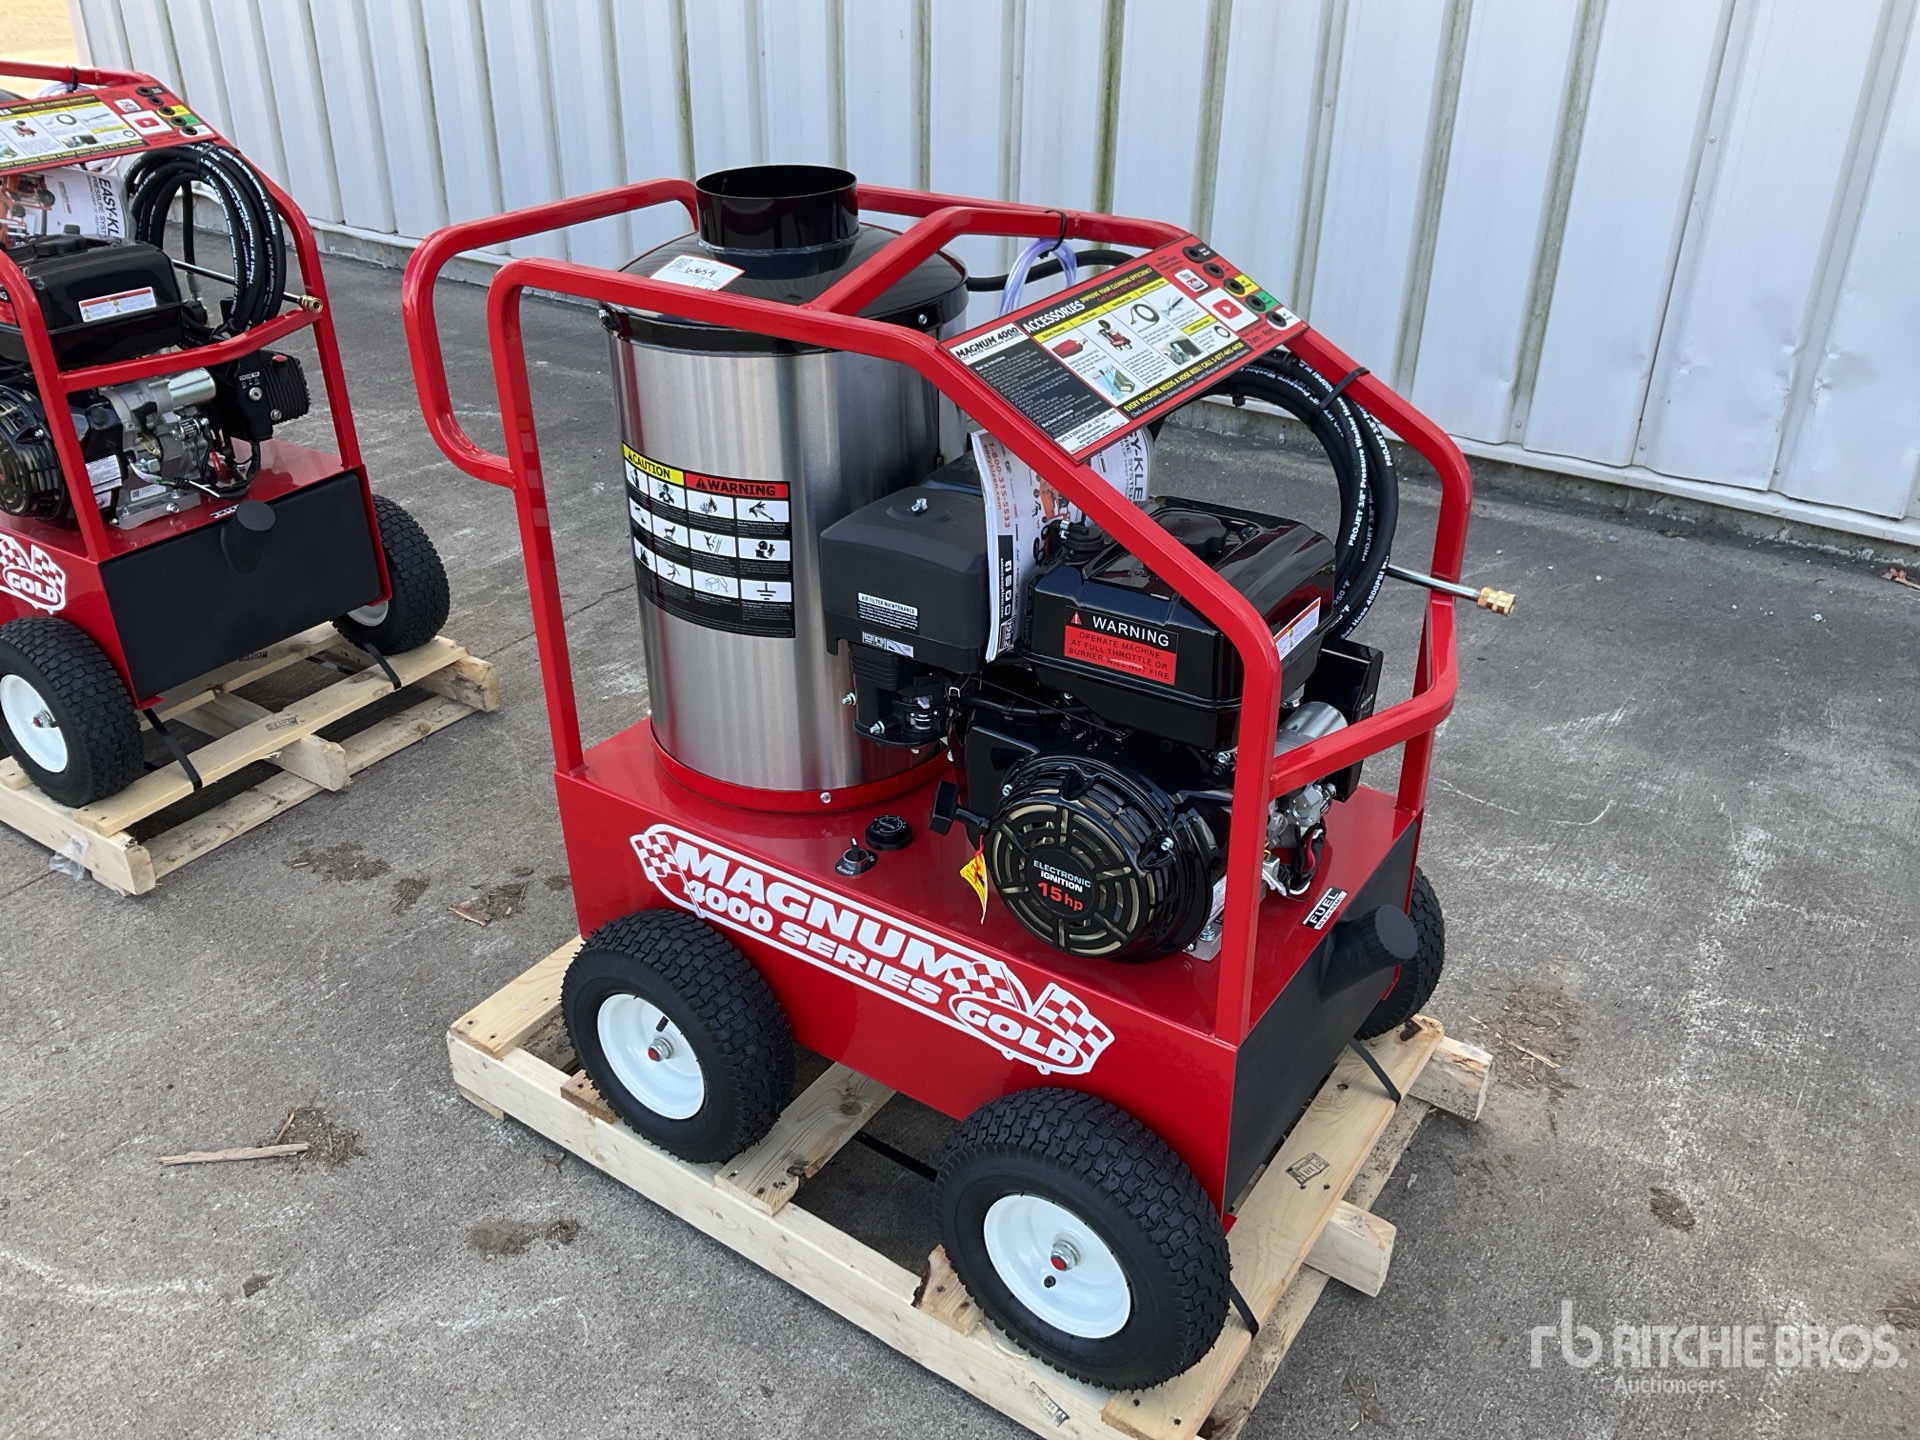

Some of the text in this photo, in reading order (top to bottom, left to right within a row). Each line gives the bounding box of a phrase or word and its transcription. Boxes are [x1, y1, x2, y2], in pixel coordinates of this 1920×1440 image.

[1019, 299, 1088, 334] ACCESSORIES
[953, 325, 1021, 359] MAGNUM 4000
[1122, 399, 1141, 412] EVERY
[1136, 387, 1163, 403] MACHINE
[1157, 379, 1177, 392] NEEDS
[1175, 370, 1192, 381] HOSE
[1199, 358, 1214, 368] CALL
[632, 454, 671, 480] CAUTION
[1376, 435, 1393, 467] PROJET
[707, 479, 776, 497] WARNING
[983, 444, 1002, 511] easykleen.com
[988, 441, 1011, 528] 1-800-315-5533
[1336, 396, 1369, 547] PROJET 3/8" Pressure Washer Hose
[6, 571, 58, 603] GOLD
[1351, 606, 1369, 627] Hose
[1366, 569, 1385, 606] 4500PSI
[869, 596, 884, 606] FILTER
[884, 600, 916, 615] MAINTENANCE
[1079, 631, 1161, 659] OPERATE MACHINE
[1092, 615, 1170, 647] WARNING
[1068, 647, 1170, 680] BURNER WILL NOT FIRE
[1071, 639, 1168, 670] AT FULL THROTTLE OR
[1032, 859, 1092, 889] ELECTRONIC
[1040, 869, 1084, 893] IGNITION
[675, 840, 967, 982] MAGNUM
[1309, 892, 1340, 925] FUEL
[682, 879, 943, 1004] 4000 SERIES
[956, 1000, 1079, 1066] GOLD
